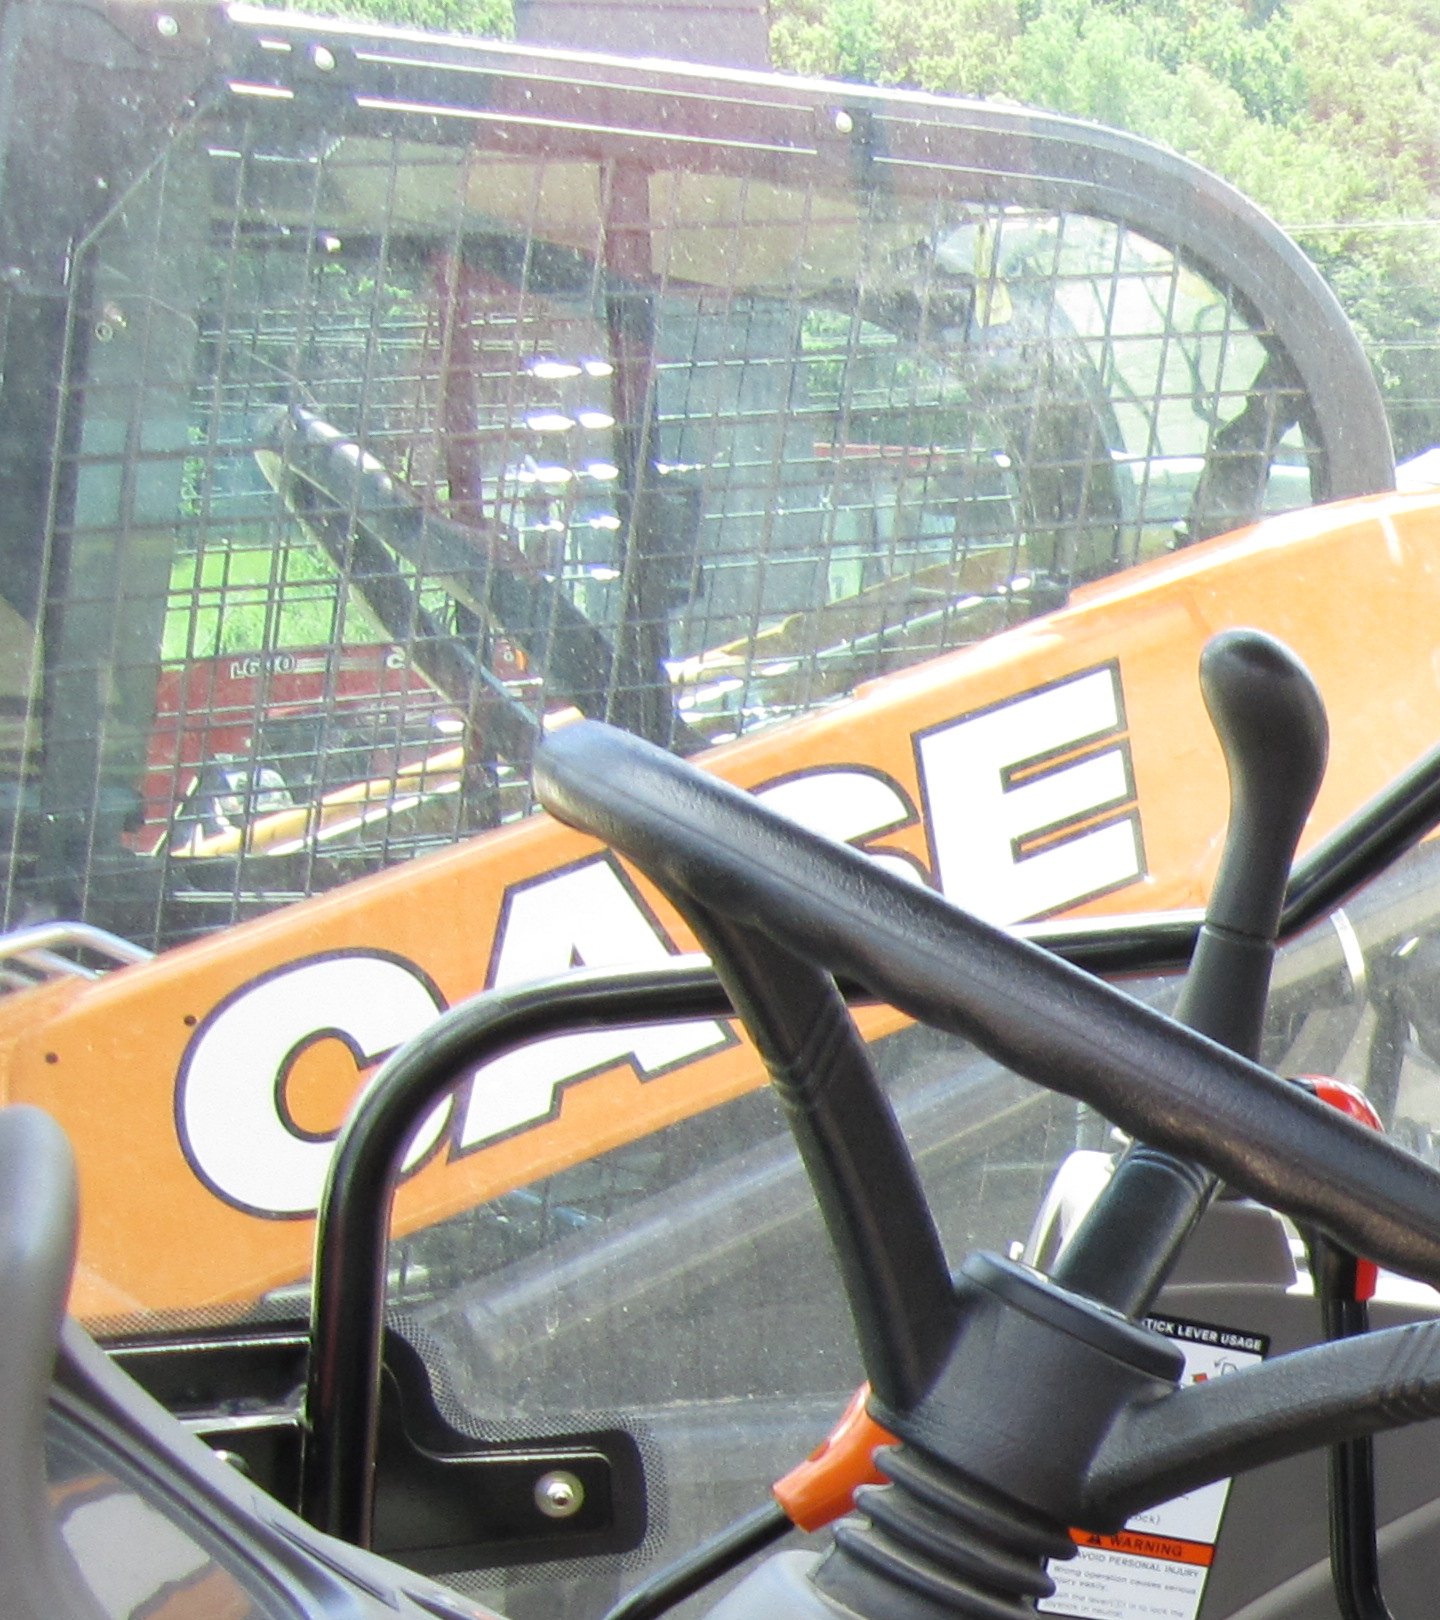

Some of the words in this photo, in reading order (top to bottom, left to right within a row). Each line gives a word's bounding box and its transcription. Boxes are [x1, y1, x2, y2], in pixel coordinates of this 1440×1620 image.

[230, 654, 297, 679] L60
[1177, 1323, 1219, 1343] LEVER
[1220, 1333, 1263, 1351] USAGE
[1108, 1535, 1183, 1557] WARNING
[1108, 1557, 1161, 1572] PERSONAL
[1164, 1566, 1200, 1577] INJURY
